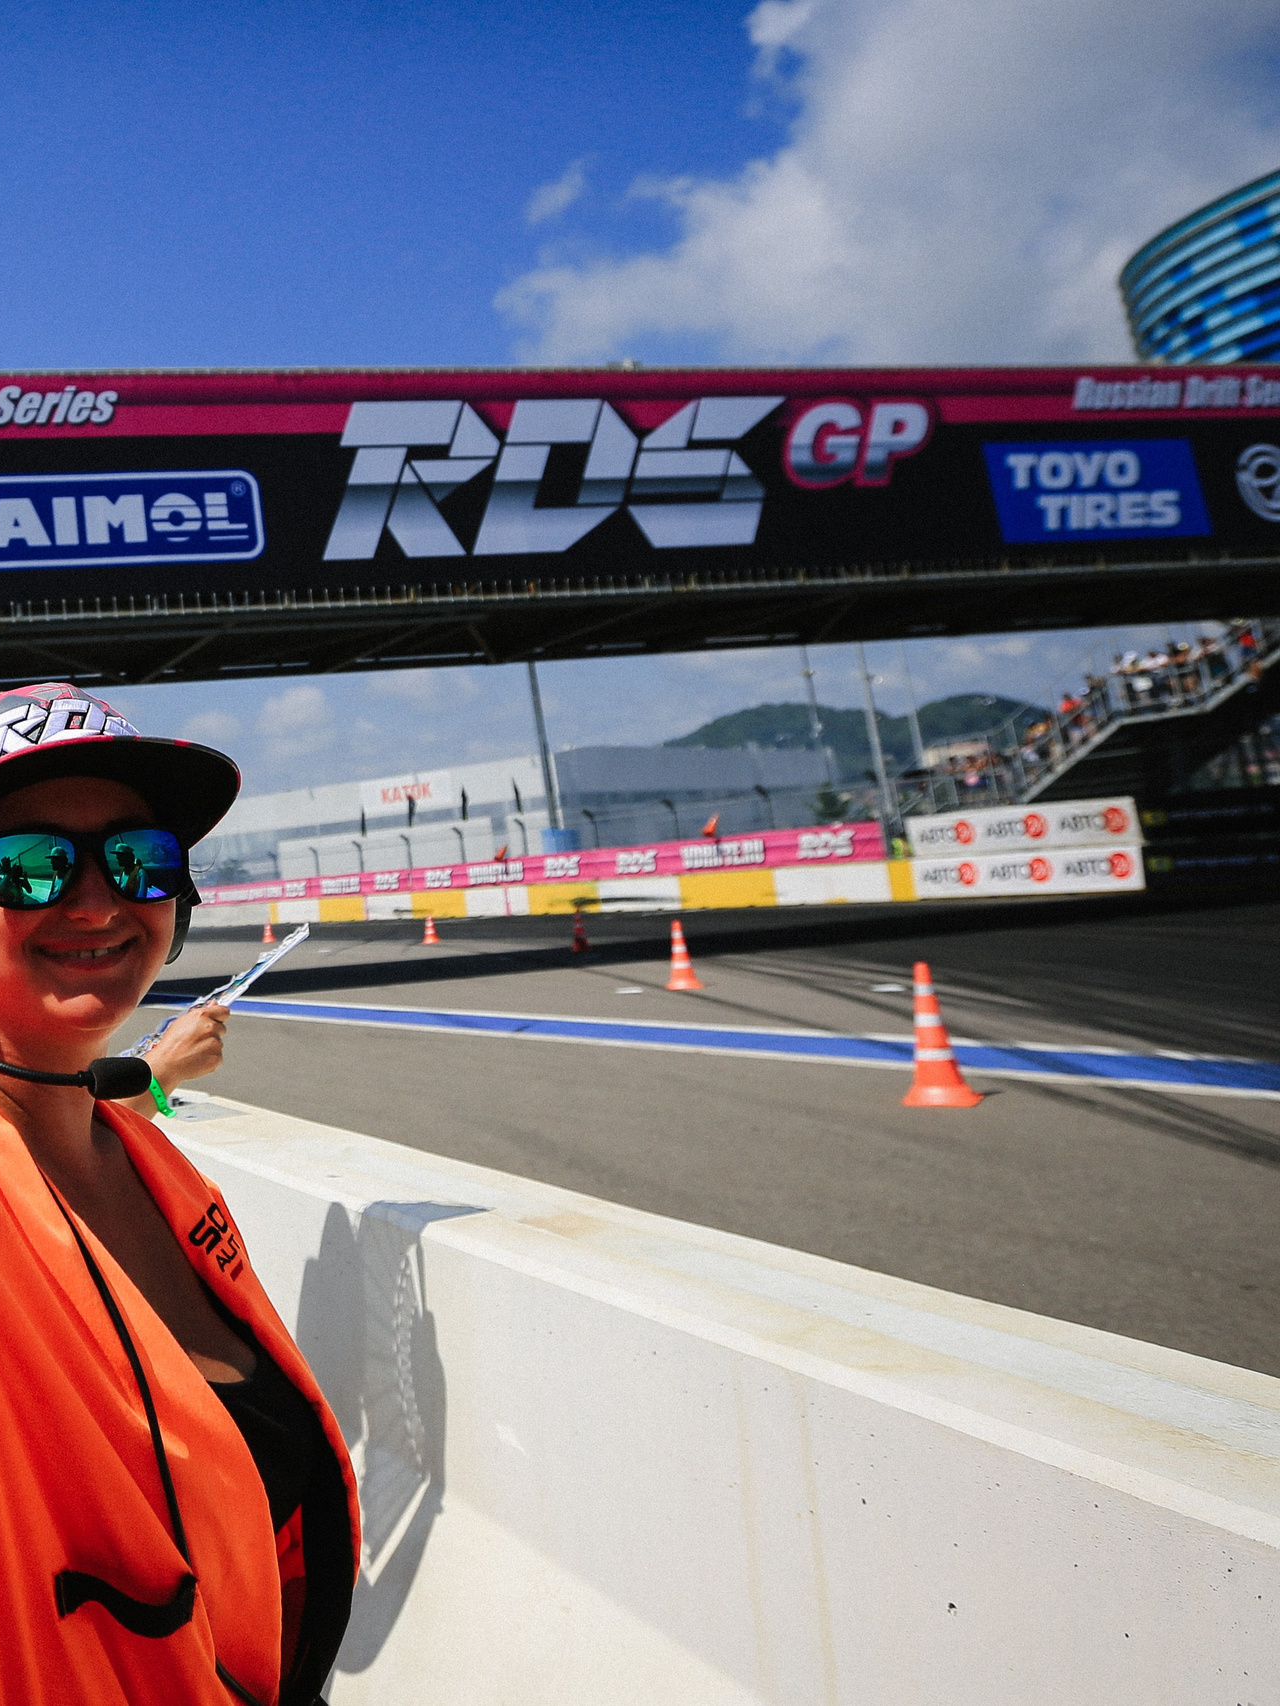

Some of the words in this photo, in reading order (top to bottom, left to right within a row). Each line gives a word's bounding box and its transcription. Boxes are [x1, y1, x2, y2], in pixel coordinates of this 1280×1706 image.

[785, 398, 931, 487] GP
[1006, 451, 1140, 489] TOYO
[322, 396, 786, 561] RDS
[1037, 491, 1181, 531] TIRES
